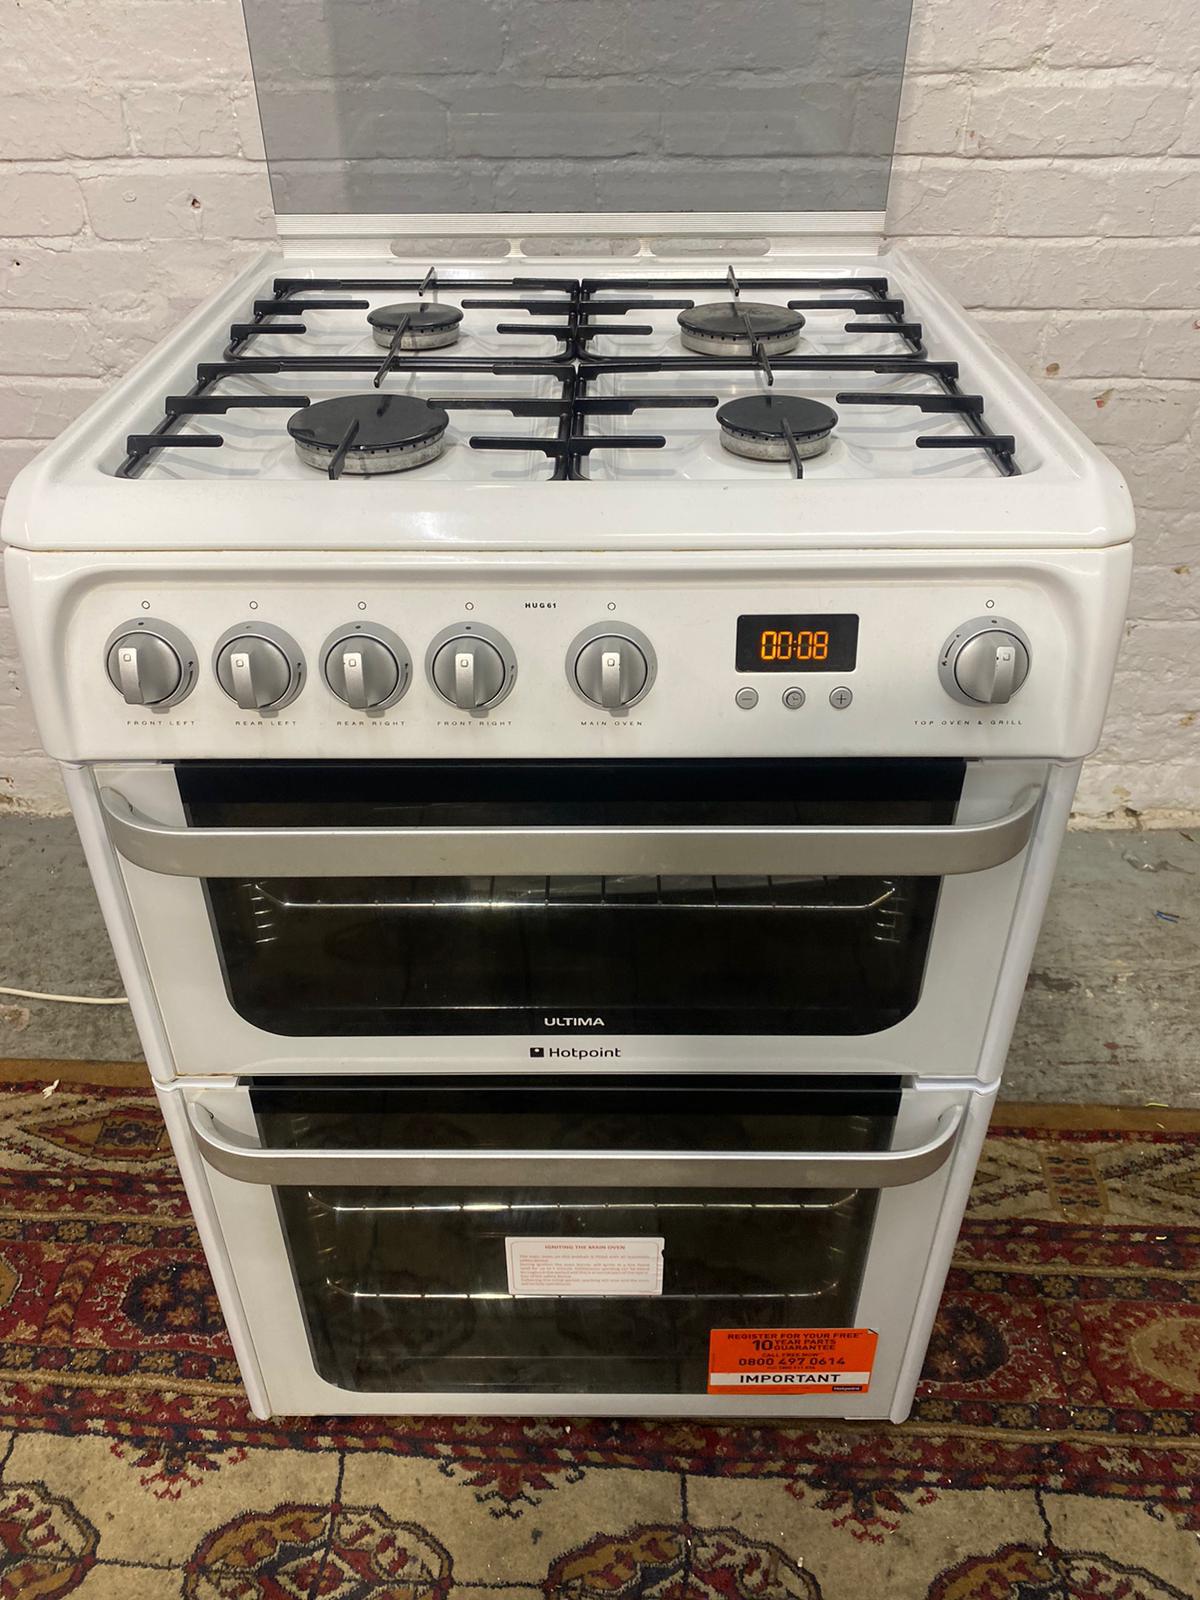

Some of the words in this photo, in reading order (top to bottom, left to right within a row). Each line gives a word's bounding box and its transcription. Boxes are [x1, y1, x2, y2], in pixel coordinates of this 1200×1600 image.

[760, 630, 829, 660] 00:08
[544, 1017, 605, 1026] ULTIMA
[549, 1047, 622, 1060] Hotpoint
[752, 1340, 773, 1351] 10
[738, 1358, 774, 1366] 0800
[809, 1357, 845, 1365] 0614
[740, 1374, 841, 1383] IMPORTANT
